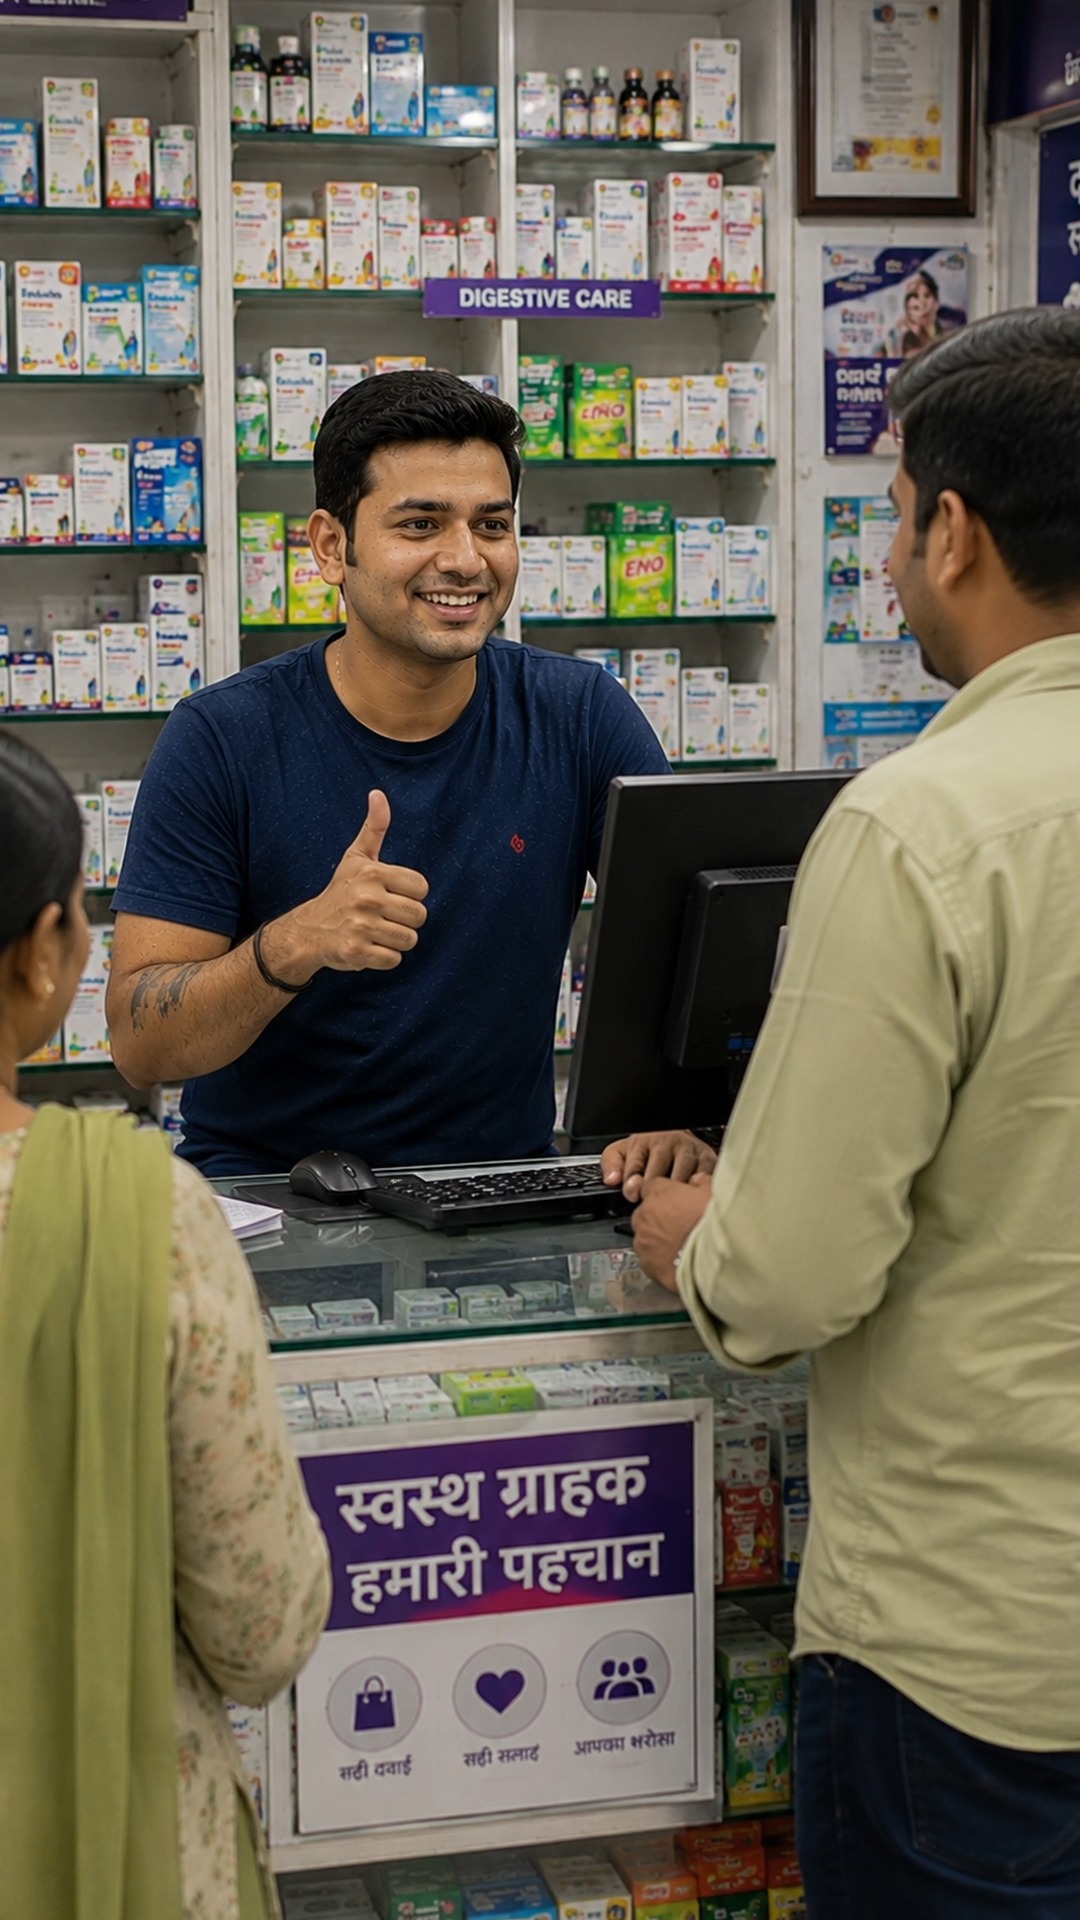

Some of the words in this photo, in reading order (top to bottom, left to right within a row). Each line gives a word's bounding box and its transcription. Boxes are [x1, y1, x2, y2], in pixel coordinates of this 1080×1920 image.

[459, 287, 570, 309] DIGESTIVE
[575, 288, 633, 309] CARE
[625, 555, 664, 578] ENO
[335, 1471, 485, 1533] स्वस्थ
[497, 1455, 650, 1519] ग्राहक
[346, 1535, 488, 1614] हमारी
[499, 1532, 665, 1593] पहचान
